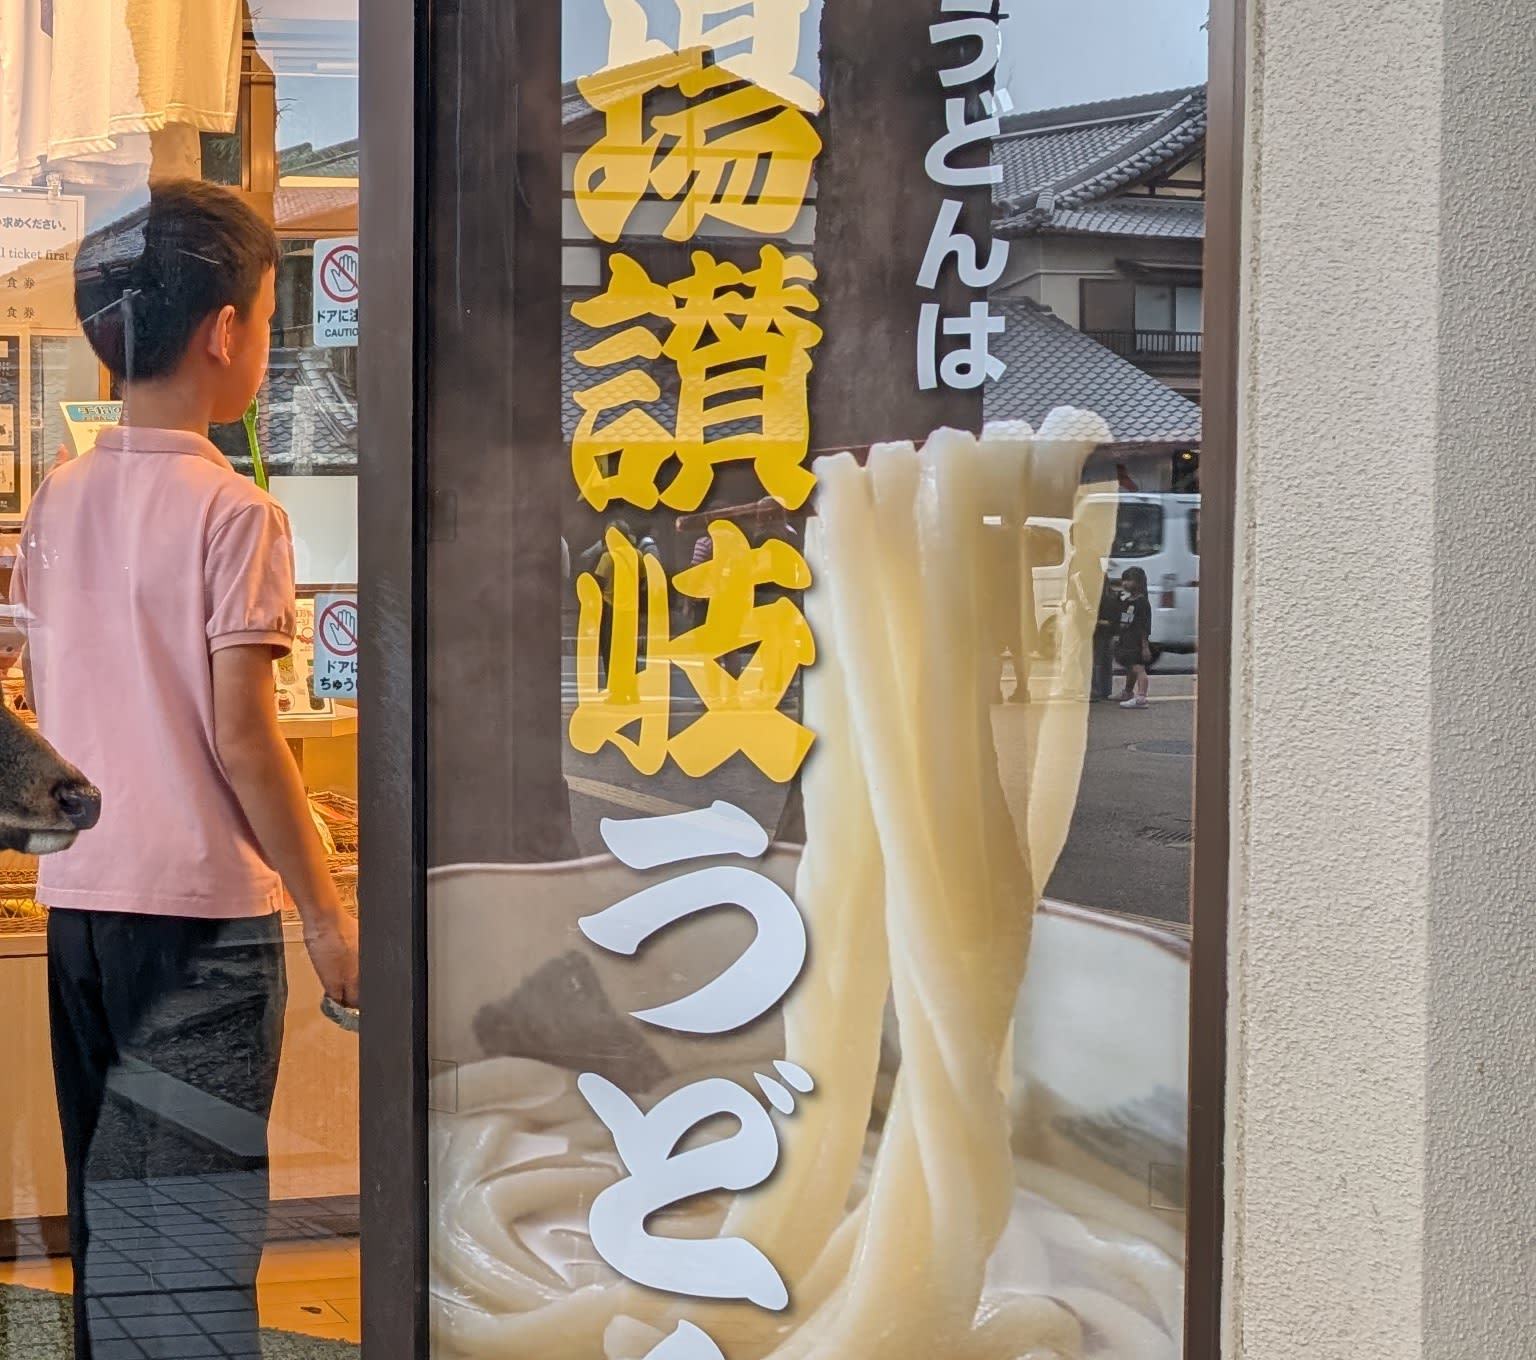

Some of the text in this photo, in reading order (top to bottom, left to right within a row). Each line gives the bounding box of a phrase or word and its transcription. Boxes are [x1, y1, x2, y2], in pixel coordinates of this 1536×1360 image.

[8, 248, 42, 260] ticket
[45, 249, 73, 261] first.
[325, 327, 358, 338] CAUTIO
[320, 677, 358, 692] ちゅう
